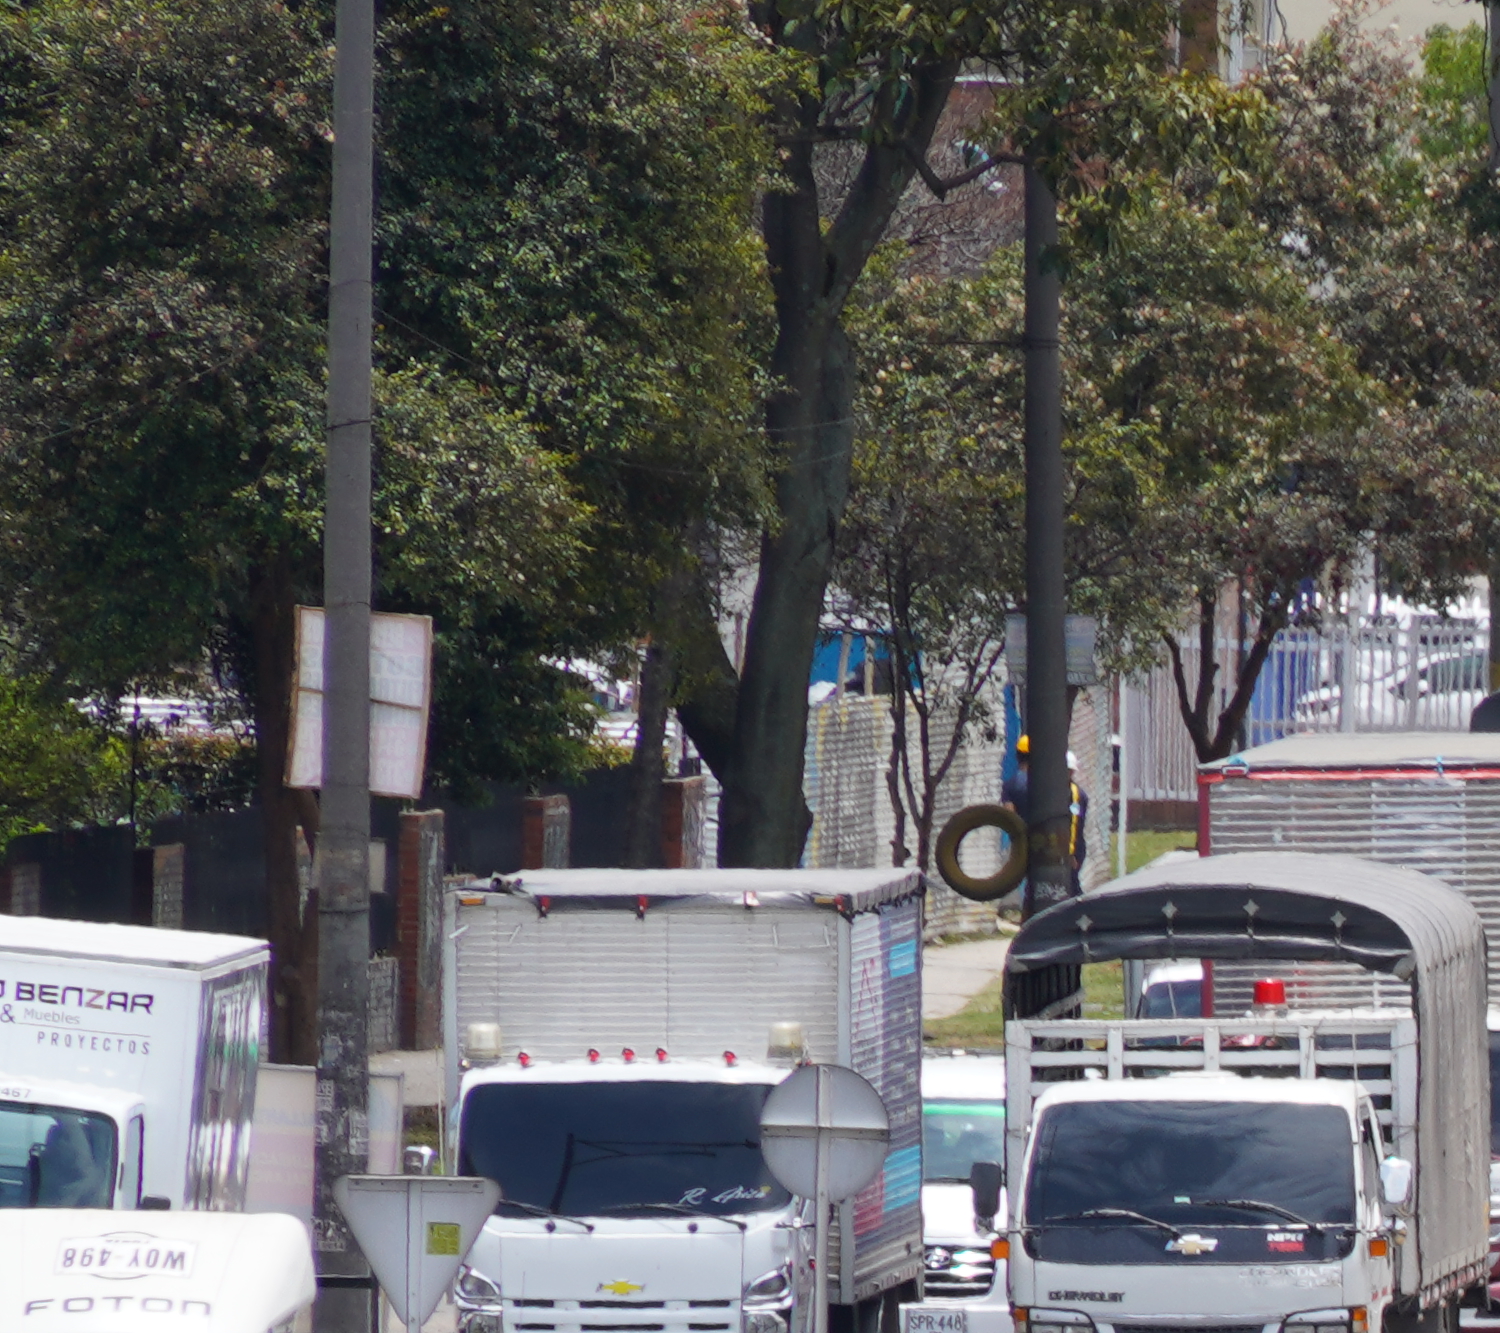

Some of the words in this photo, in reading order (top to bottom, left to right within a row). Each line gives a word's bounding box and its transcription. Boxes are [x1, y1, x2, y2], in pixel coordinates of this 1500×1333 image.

[24, 1006, 81, 1025] Muebles
[37, 1030, 151, 1055] PROYECTOS
[23, 1296, 212, 1316] FOTON
